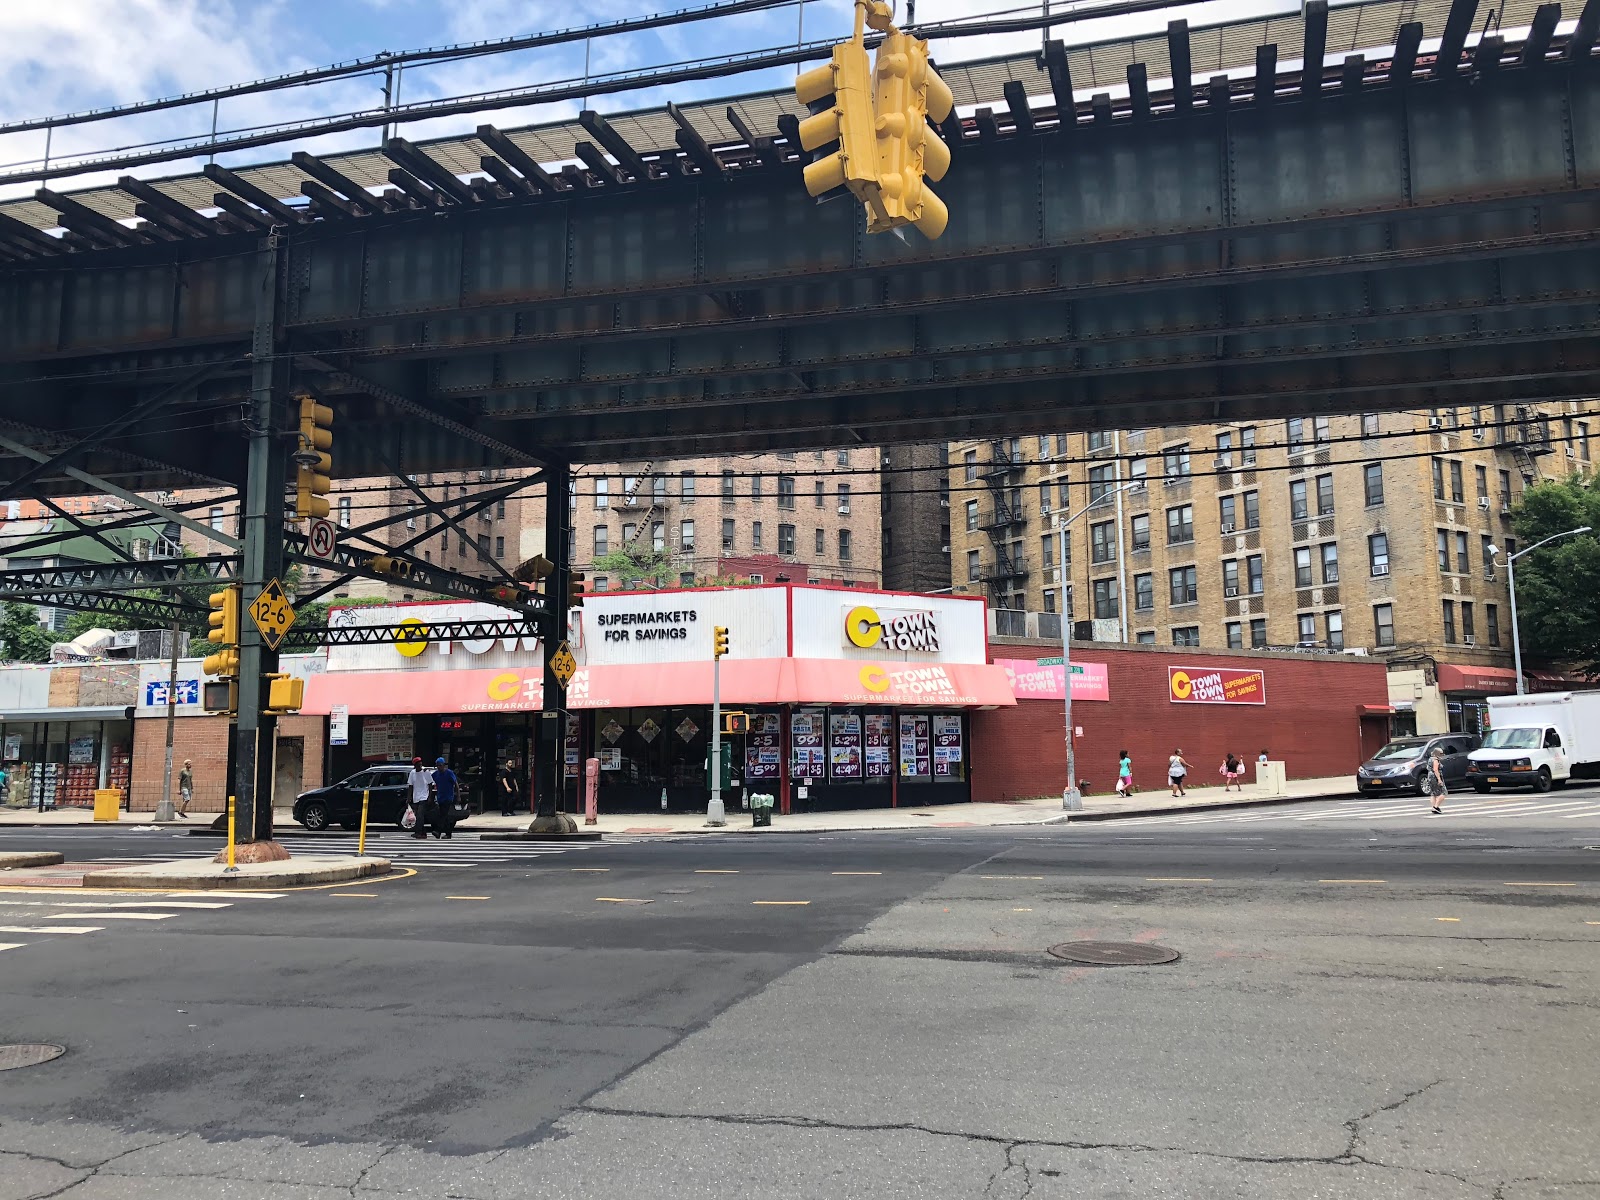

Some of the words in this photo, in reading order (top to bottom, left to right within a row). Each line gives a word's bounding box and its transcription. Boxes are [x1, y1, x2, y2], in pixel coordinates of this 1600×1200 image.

[598, 610, 697, 626] SUPERMARKETS
[605, 629, 629, 642] FOR
[635, 627, 687, 641] SAVINGS
[845, 606, 882, 649] C
[880, 611, 936, 637] TOWN
[883, 627, 940, 651] TOWN
[1038, 657, 1063, 666] BROADWAY
[889, 666, 947, 684] TOWN
[1017, 670, 1054, 684] TOWN
[1190, 673, 1222, 690] TOWN
[1224, 673, 1261, 690] SUPERMARKETS
[895, 677, 953, 695] TOWN
[1019, 680, 1057, 692] TOWN
[1192, 684, 1224, 700] TOWN
[1226, 690, 1237, 699] FOR
[1237, 684, 1257, 696] SAVINGS
[844, 693, 914, 703] SUPERMARKET
[461, 702, 537, 711] SUPERMARKET
